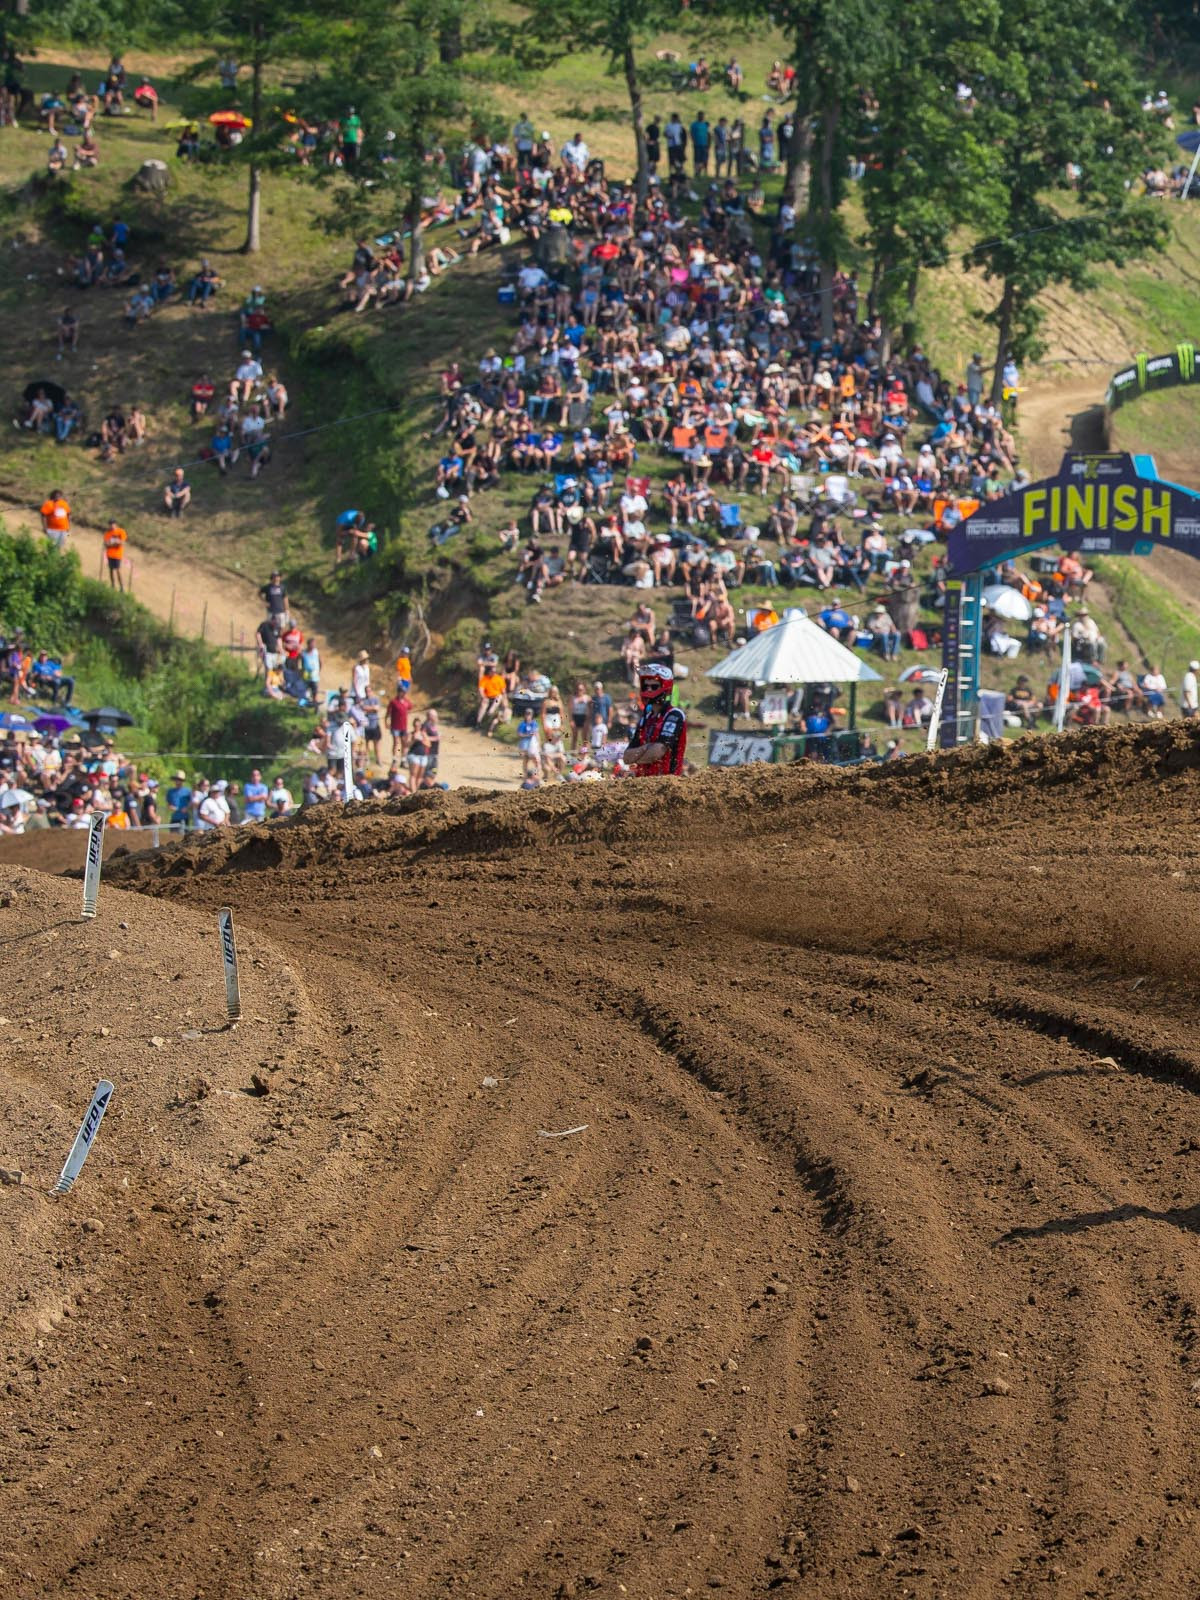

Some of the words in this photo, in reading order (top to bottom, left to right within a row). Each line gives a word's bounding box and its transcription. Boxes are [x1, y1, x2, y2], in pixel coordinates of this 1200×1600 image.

[1022, 484, 1172, 537] FINISH
[89, 831, 98, 865] UFO
[223, 930, 234, 966] UFO
[82, 1104, 99, 1144] UFO
